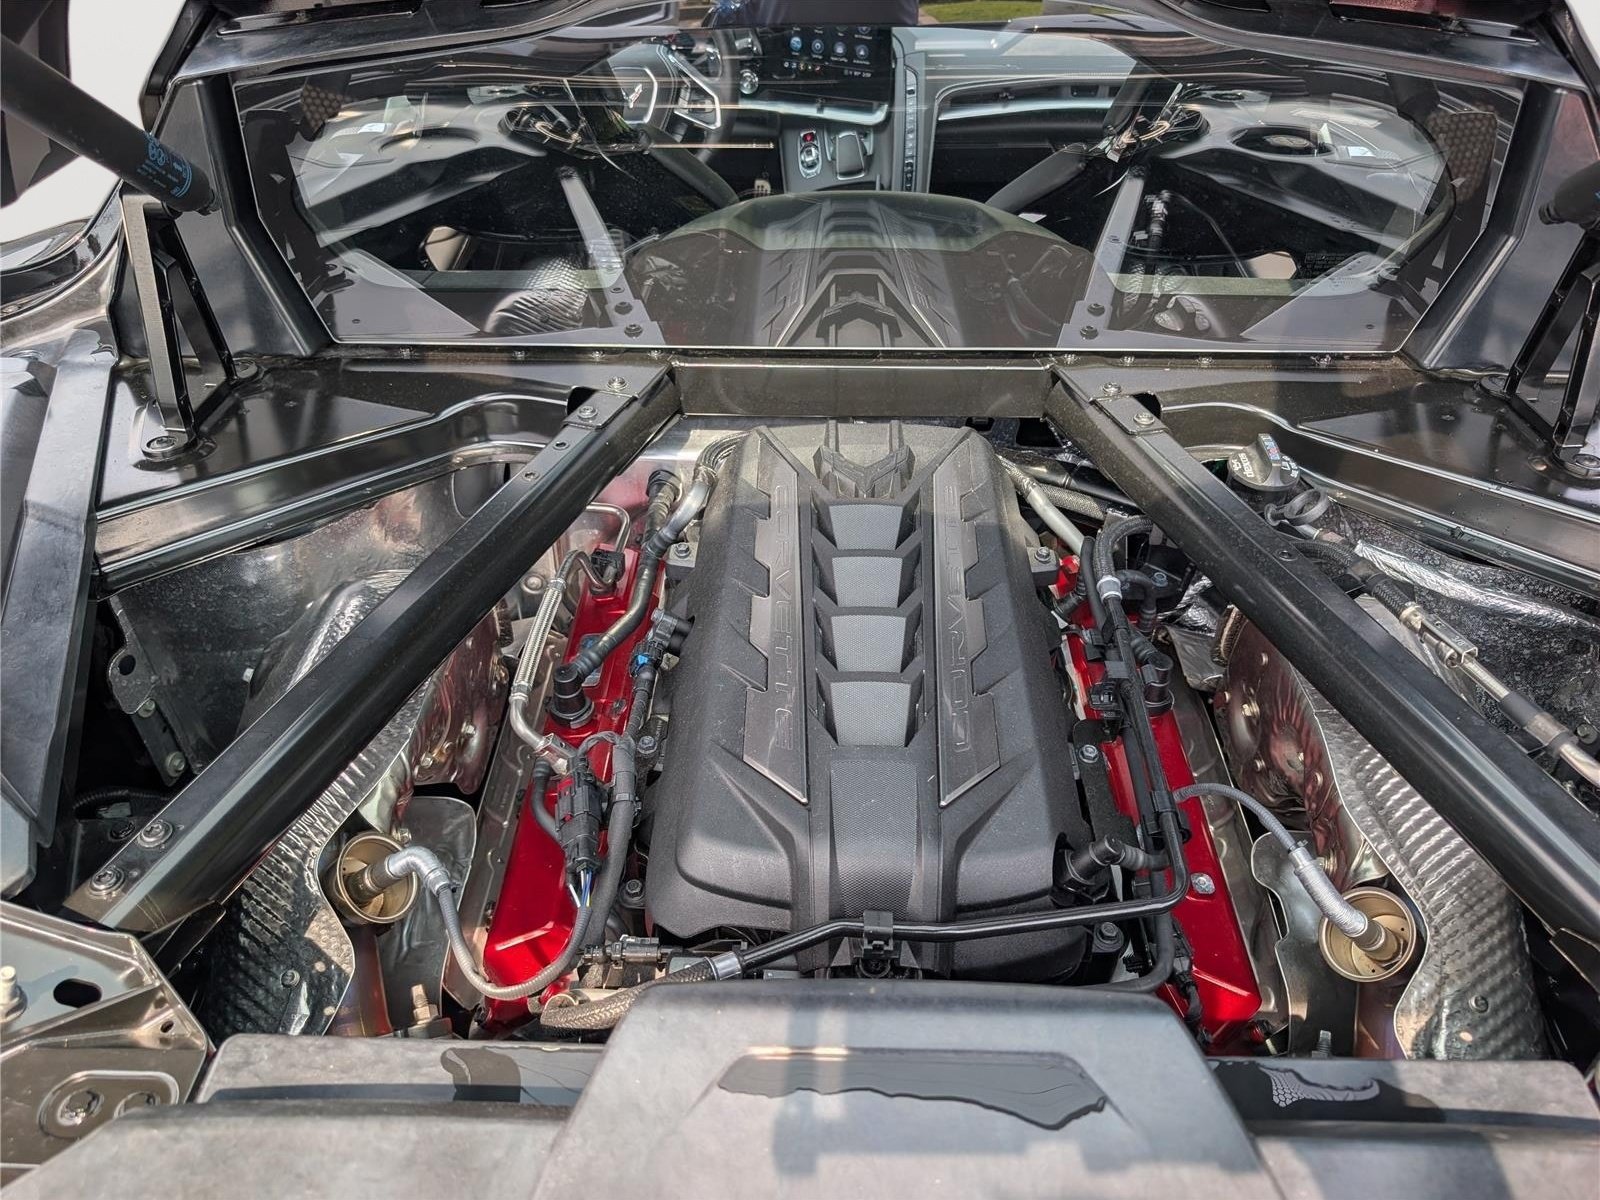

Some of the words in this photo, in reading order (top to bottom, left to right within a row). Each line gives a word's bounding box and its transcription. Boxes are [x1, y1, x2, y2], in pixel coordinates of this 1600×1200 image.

[1239, 453, 1255, 478] dexos
[774, 485, 793, 750] CORVETTE
[945, 485, 971, 751] CORVETTE
